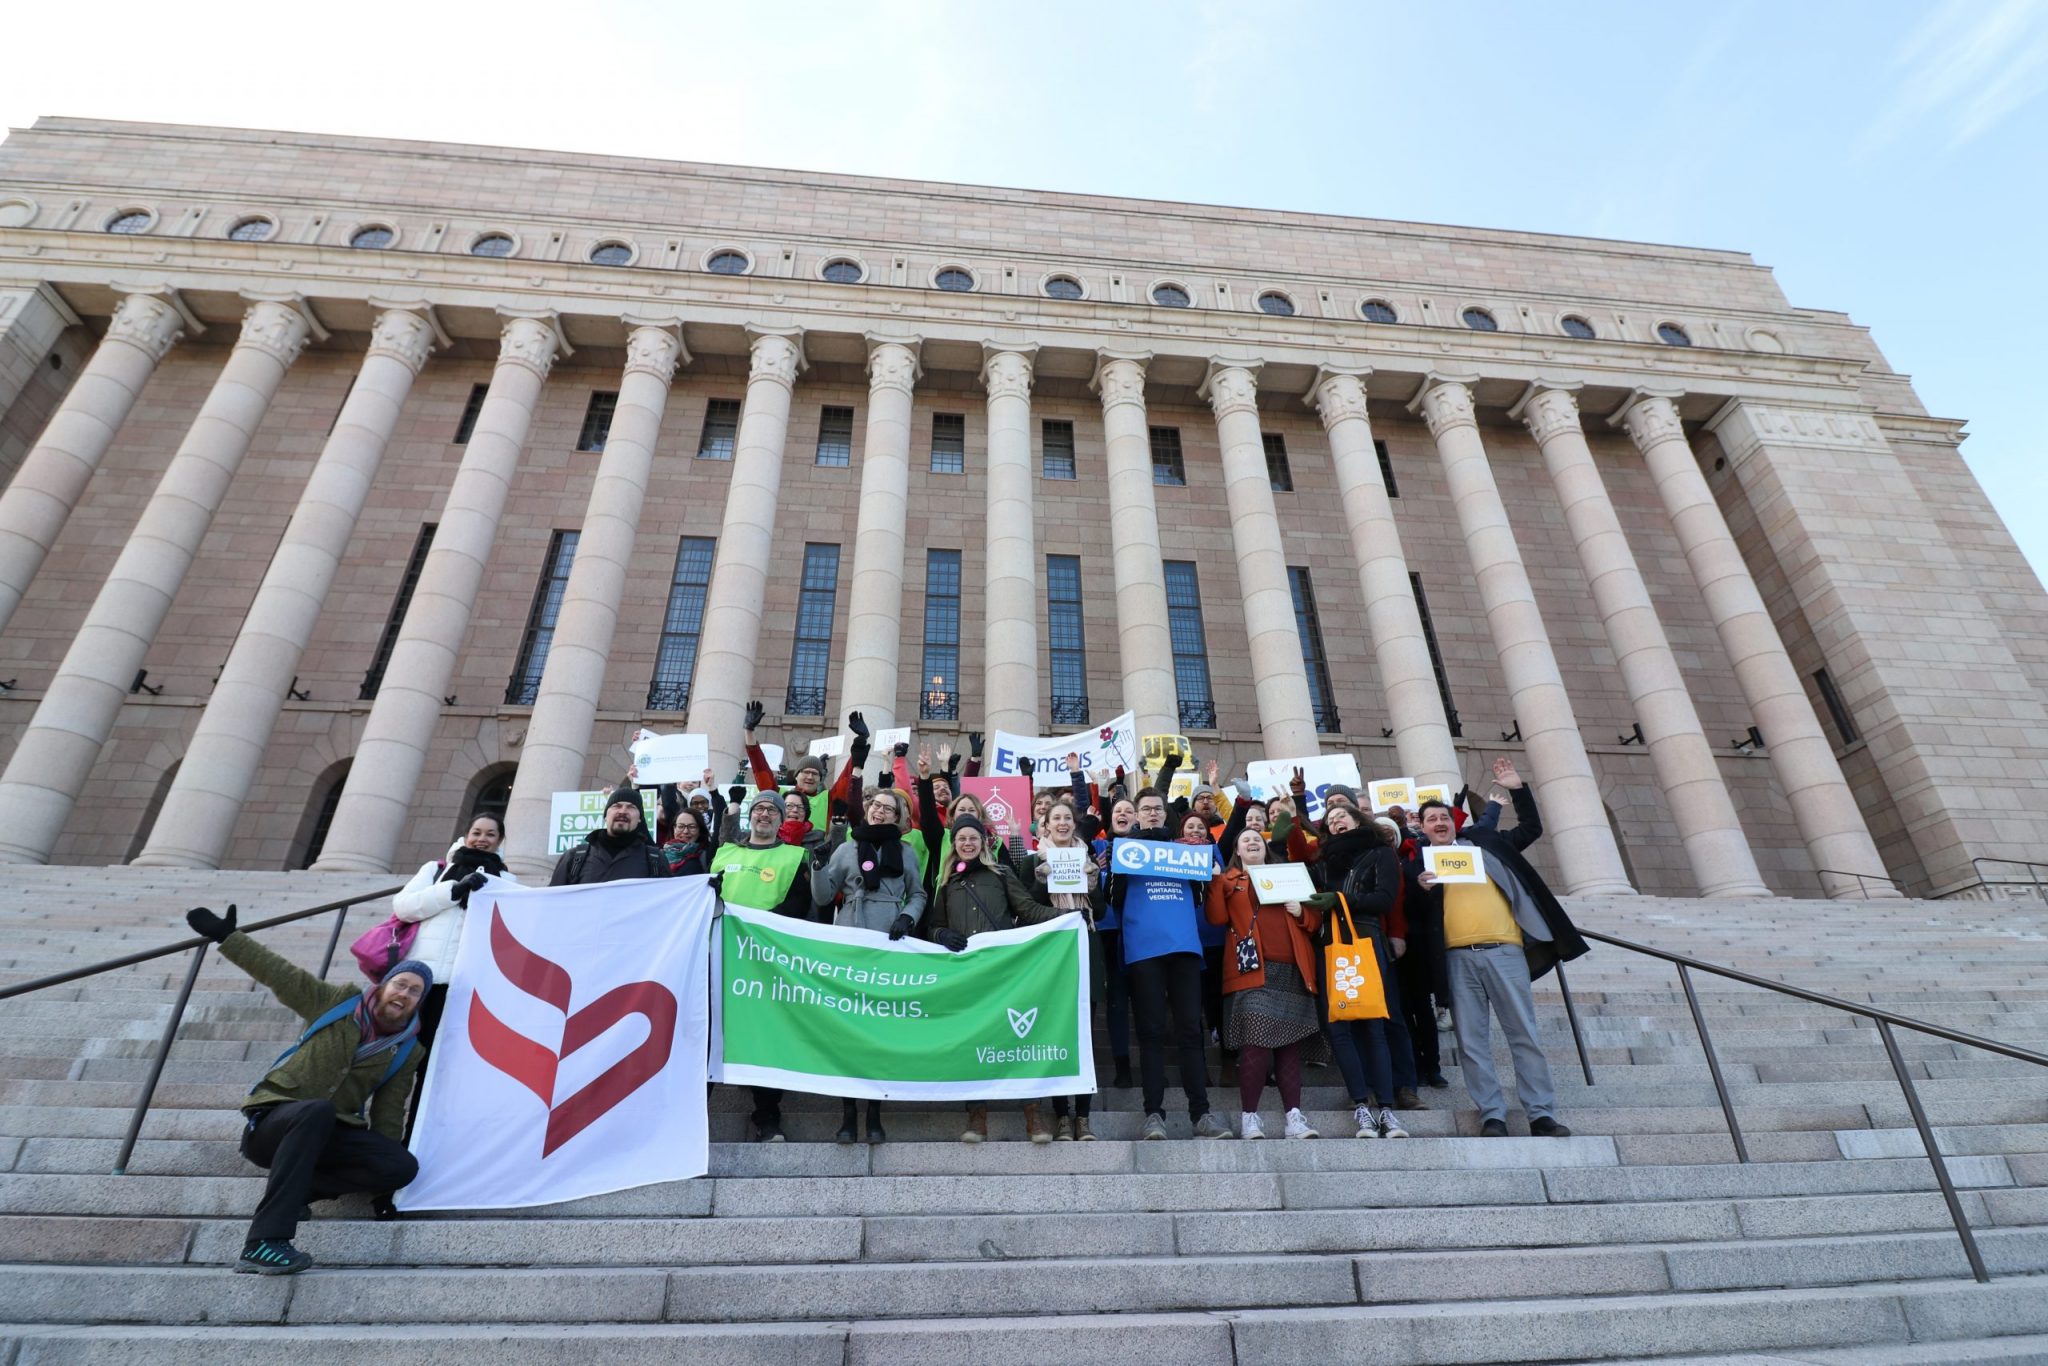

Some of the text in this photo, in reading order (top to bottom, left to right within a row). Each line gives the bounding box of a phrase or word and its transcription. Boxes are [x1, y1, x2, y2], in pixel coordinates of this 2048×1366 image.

[1144, 736, 1190, 759] UFF
[583, 793, 651, 810] FINH
[1383, 789, 1403, 798] fingo
[563, 815, 651, 830] SOM-
[1154, 847, 1208, 868] PLAN
[1441, 859, 1468, 869] fingo
[1154, 865, 1208, 876] INTERNATIONAL
[736, 935, 938, 986] Yhdenvertaisuus
[732, 976, 929, 1018] on ihmisoikeus.
[976, 1044, 1068, 1064] Väestöliitto
